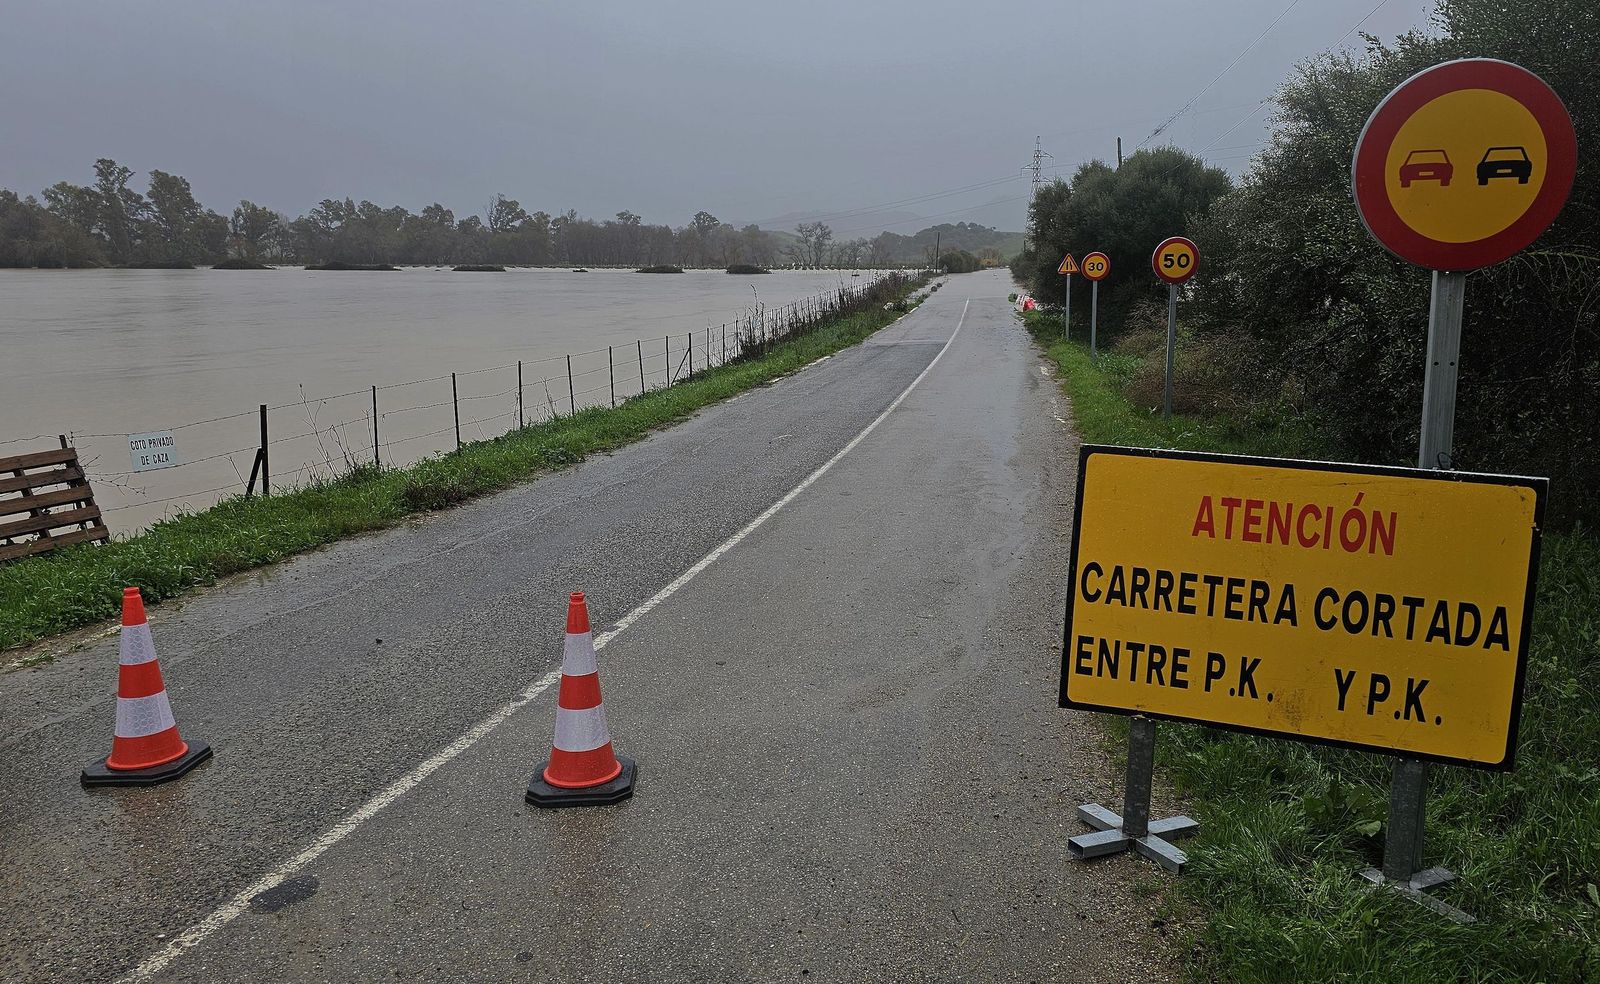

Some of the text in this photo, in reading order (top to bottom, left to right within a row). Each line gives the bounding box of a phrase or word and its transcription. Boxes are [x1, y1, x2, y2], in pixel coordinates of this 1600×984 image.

[1087, 262, 1104, 272] 30
[1163, 253, 1190, 269] 50
[130, 436, 174, 450] COTO PRIVADO
[141, 453, 170, 465] DE CAZA
[1192, 491, 1397, 556] ATENCIÓN
[1081, 561, 1510, 652] CARRETERA CORTADA
[1075, 634, 1442, 726] ENTRE P.K. Y P.K.
